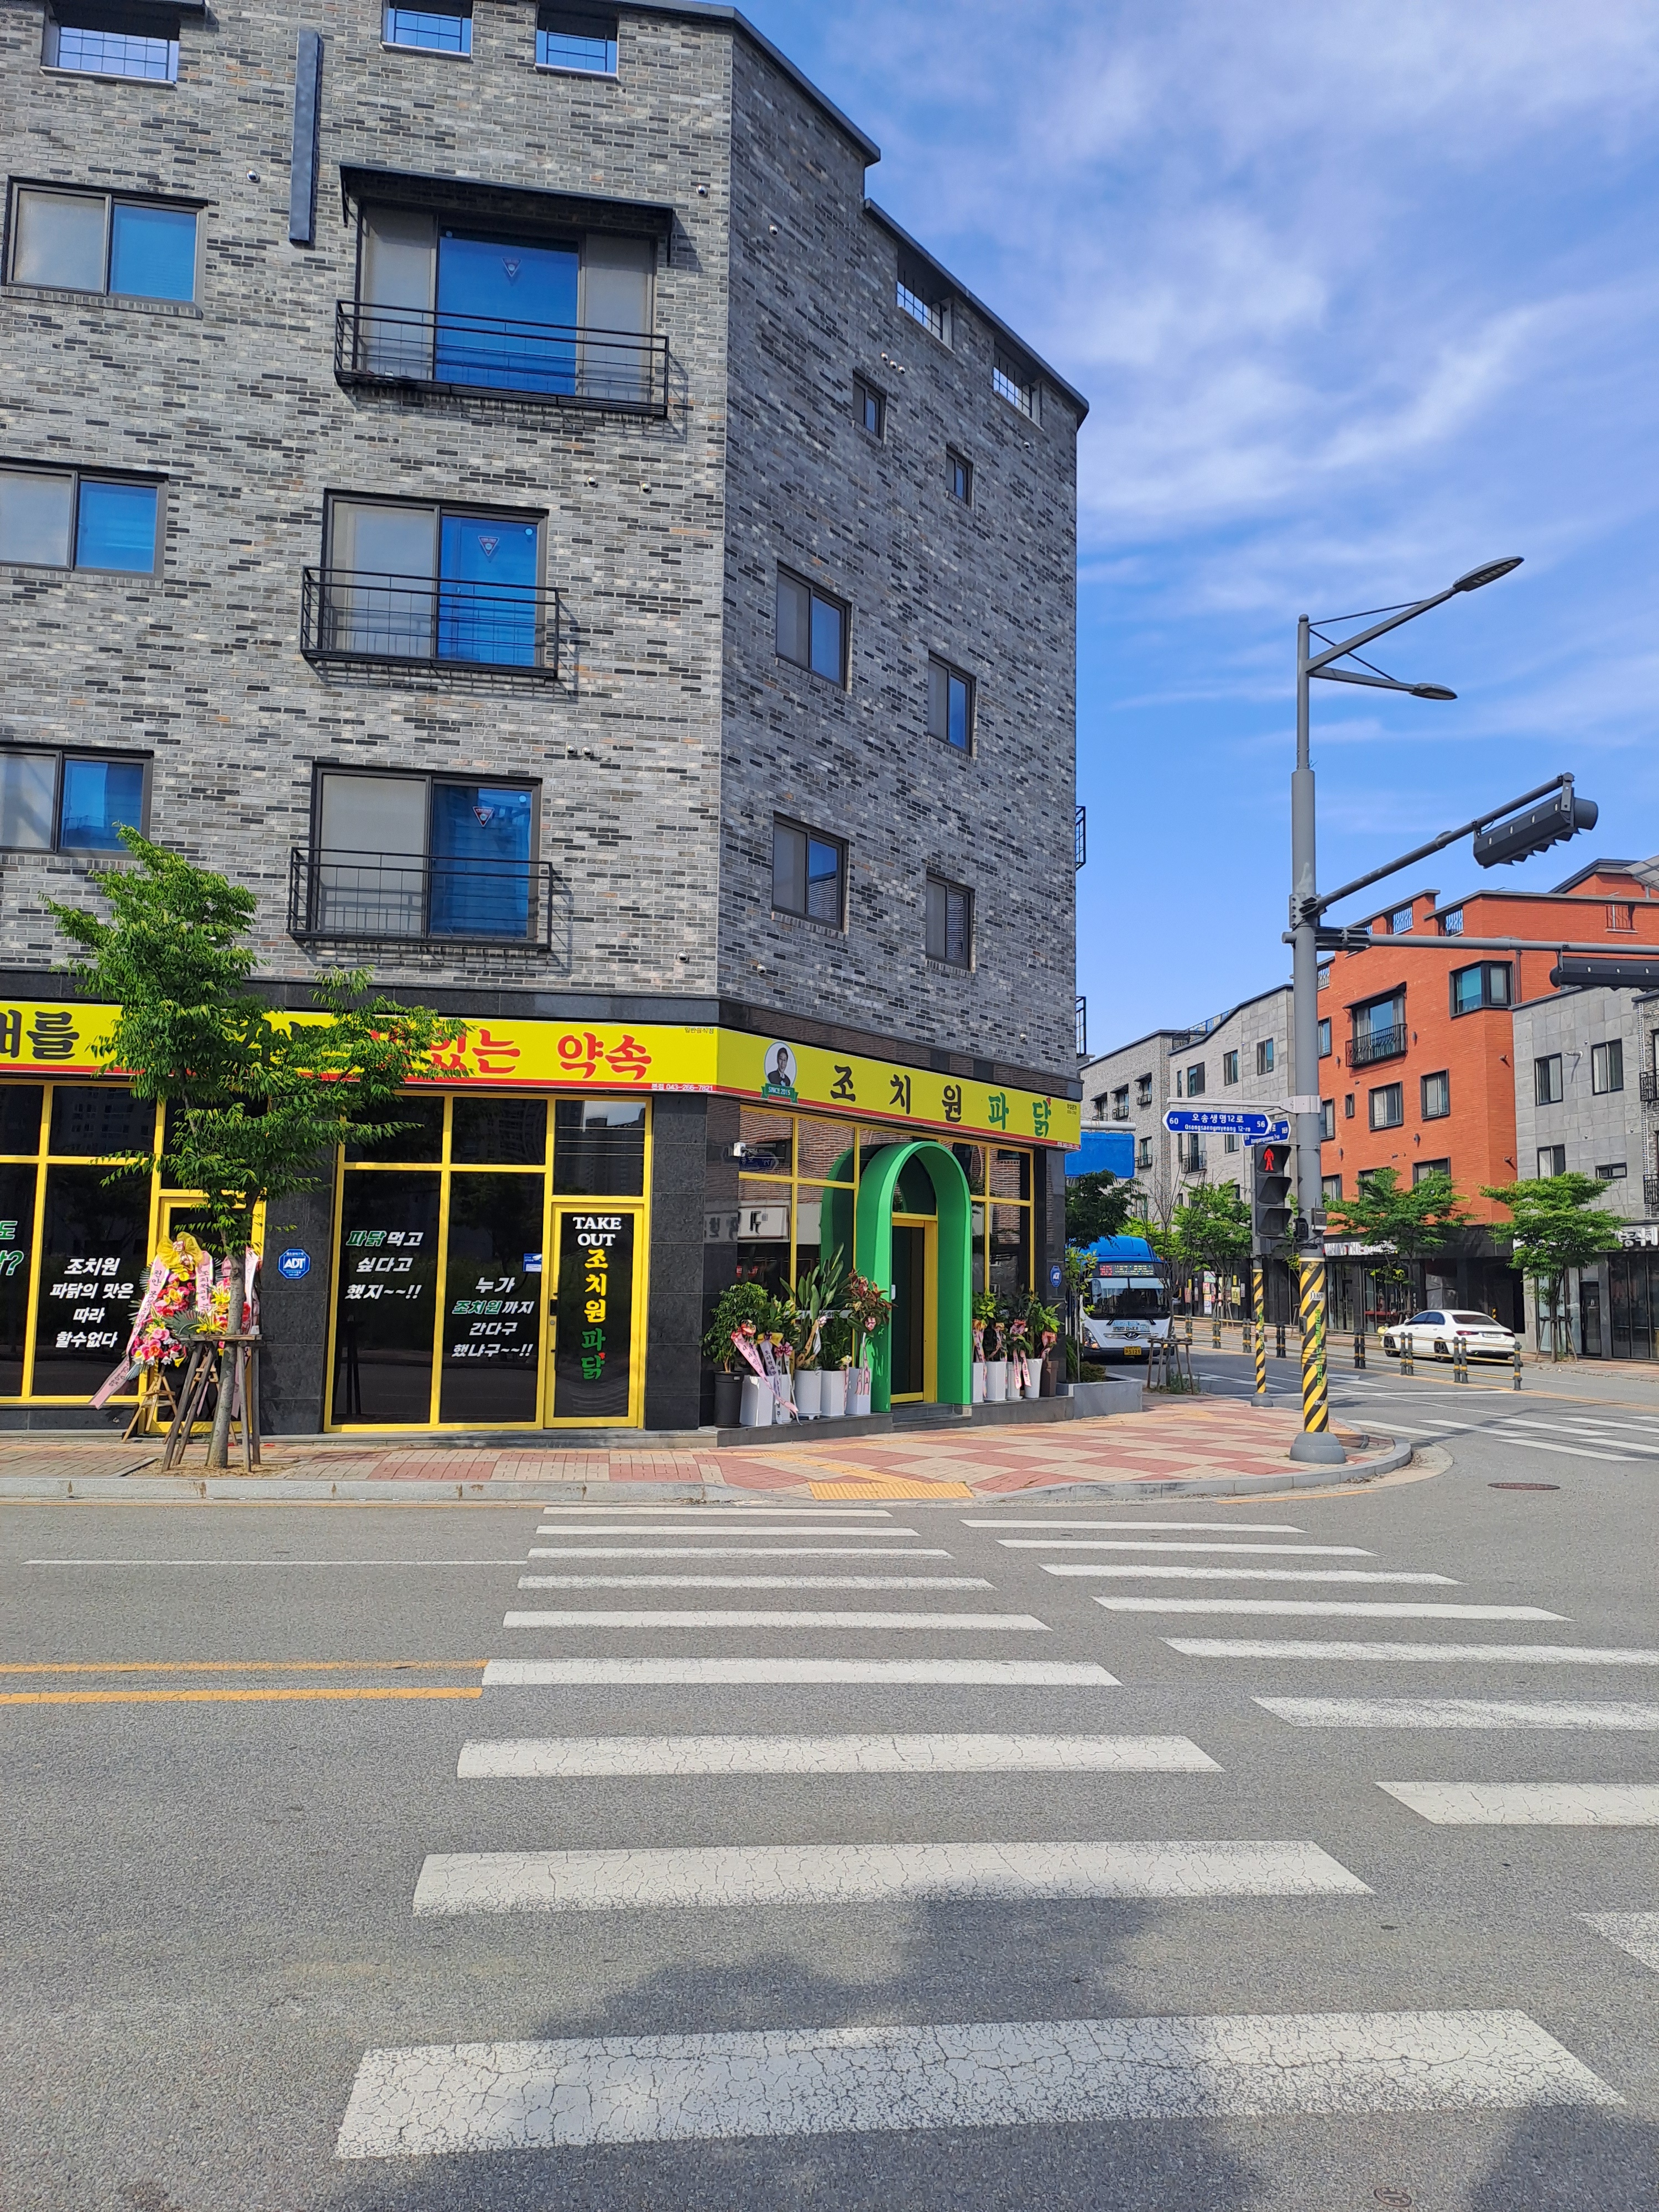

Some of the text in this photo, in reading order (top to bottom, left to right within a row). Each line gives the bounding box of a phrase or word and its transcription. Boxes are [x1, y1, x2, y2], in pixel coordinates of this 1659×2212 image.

[557, 1032, 651, 1080] 약속
[768, 1086, 780, 1094] SINCE
[1191, 1113, 1244, 1123] 오송생명12로
[1185, 1124, 1236, 1133] Osongsaengmyeong
[573, 1217, 622, 1230] TAKE
[577, 1233, 615, 1246] OUT
[64, 1258, 121, 1276] 조치원
[284, 1258, 305, 1269] ADT
[356, 1257, 413, 1272] 싶다고
[49, 1282, 134, 1299] 파닭의 맛은
[476, 1277, 515, 1293] 누가
[73, 1307, 105, 1323] 따라
[469, 1322, 518, 1336] 간다구
[55, 1331, 118, 1348] 할수없다
